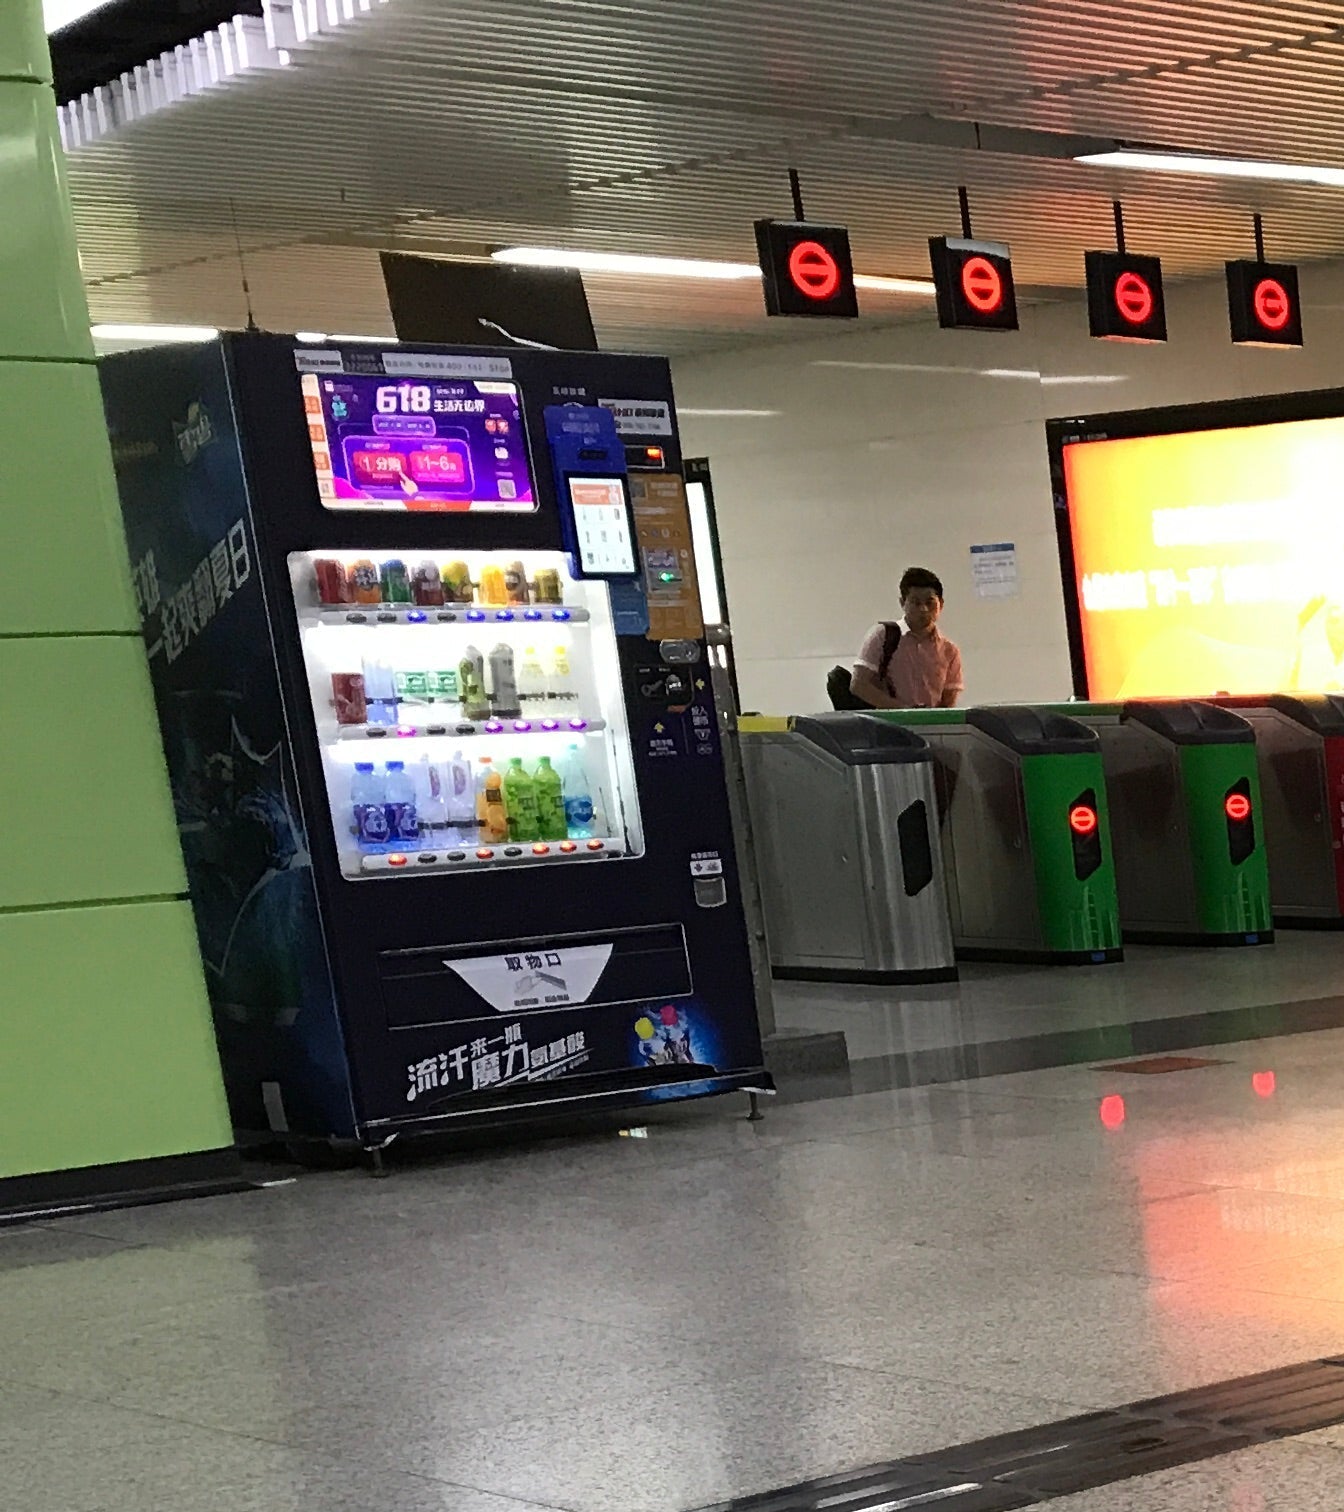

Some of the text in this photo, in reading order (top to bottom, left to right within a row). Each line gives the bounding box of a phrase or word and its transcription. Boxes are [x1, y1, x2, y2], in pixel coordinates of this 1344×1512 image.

[376, 384, 432, 414] 618
[504, 952, 562, 972] 取物口
[406, 1045, 468, 1102] 流汗
